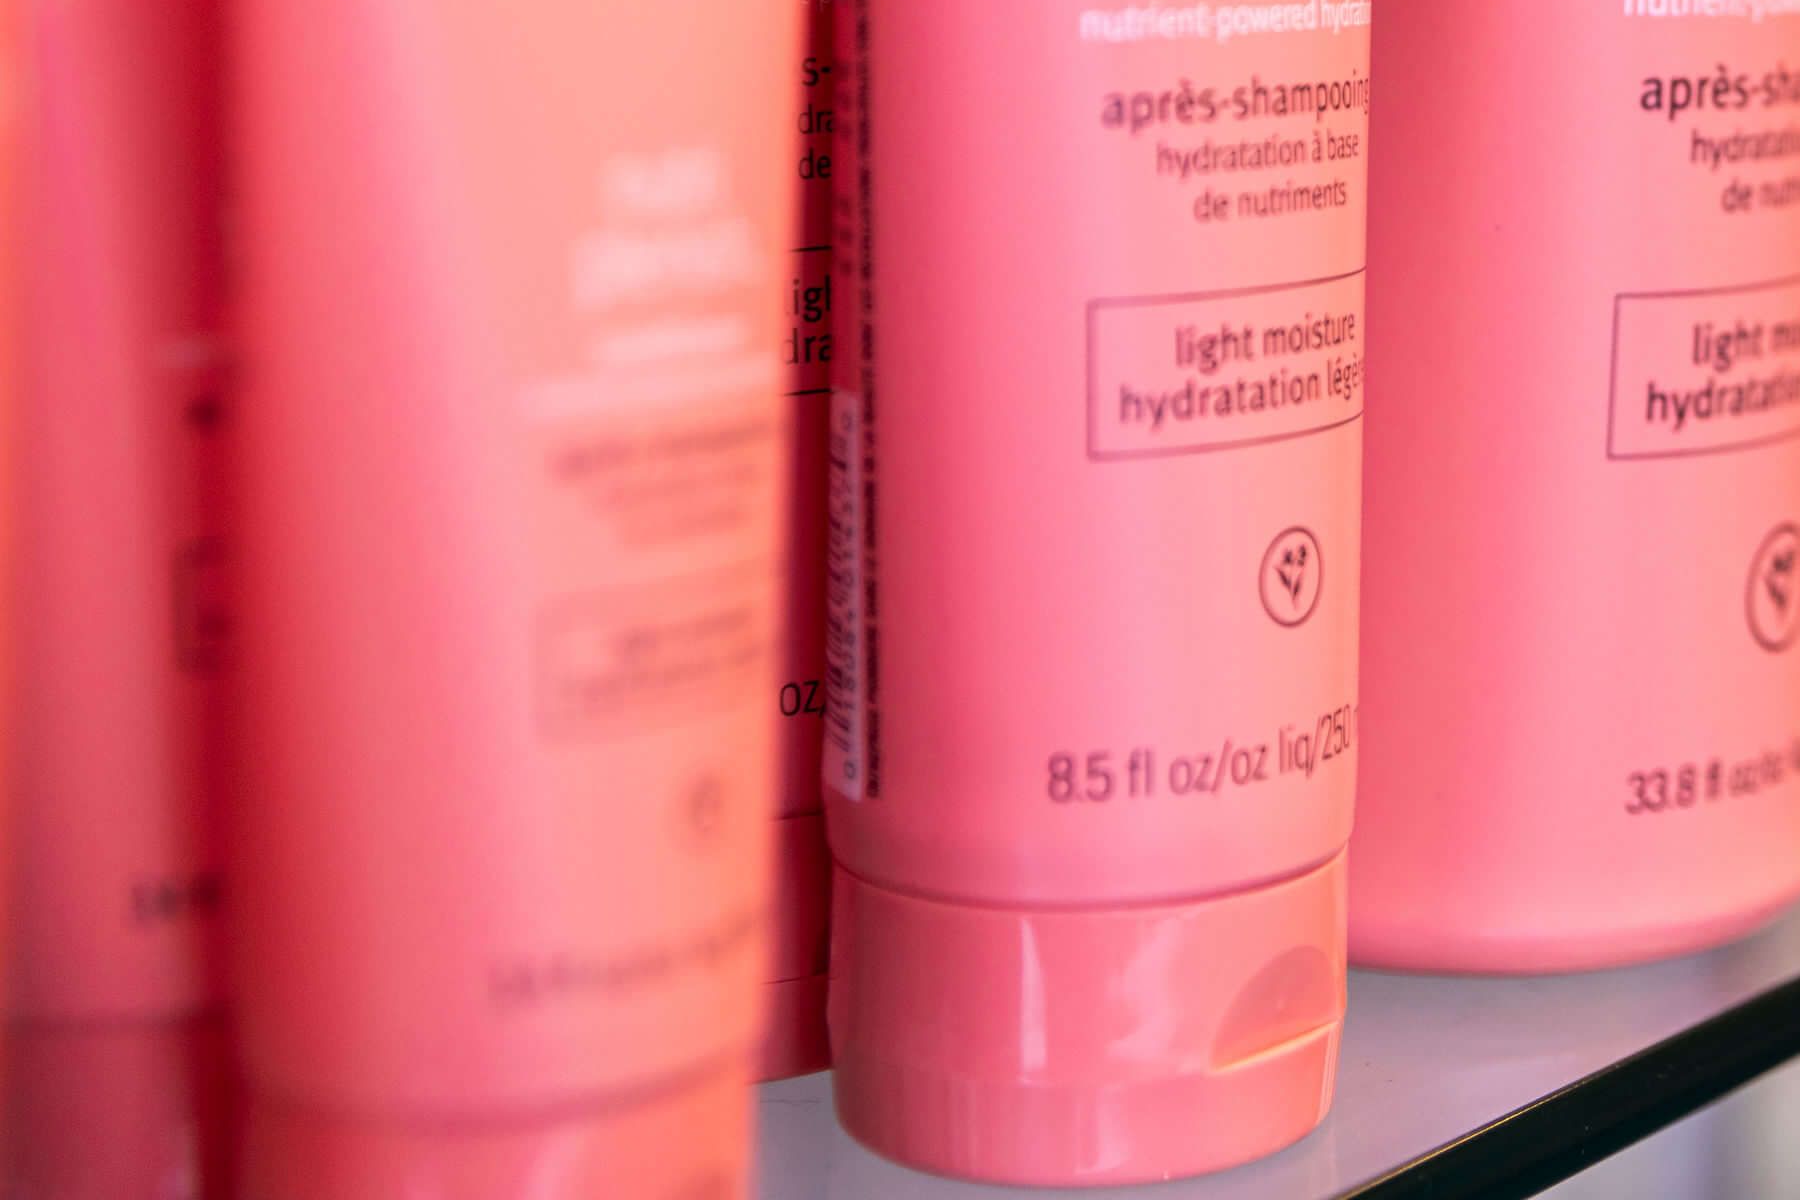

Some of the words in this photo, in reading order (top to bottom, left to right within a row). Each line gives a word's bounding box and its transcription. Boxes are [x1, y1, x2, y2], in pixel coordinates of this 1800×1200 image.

[1156, 130, 1305, 183] hydratation
[1312, 130, 1324, 164] à
[1327, 127, 1361, 160] base
[1193, 187, 1229, 224] de
[1237, 178, 1347, 219] nutriments
[1175, 321, 1255, 374] light
[1262, 313, 1356, 356] moisture
[1692, 318, 1763, 373] light
[1118, 368, 1321, 432] hydratation
[1127, 749, 1154, 799] fl
[1168, 737, 1267, 796] oz/oz
